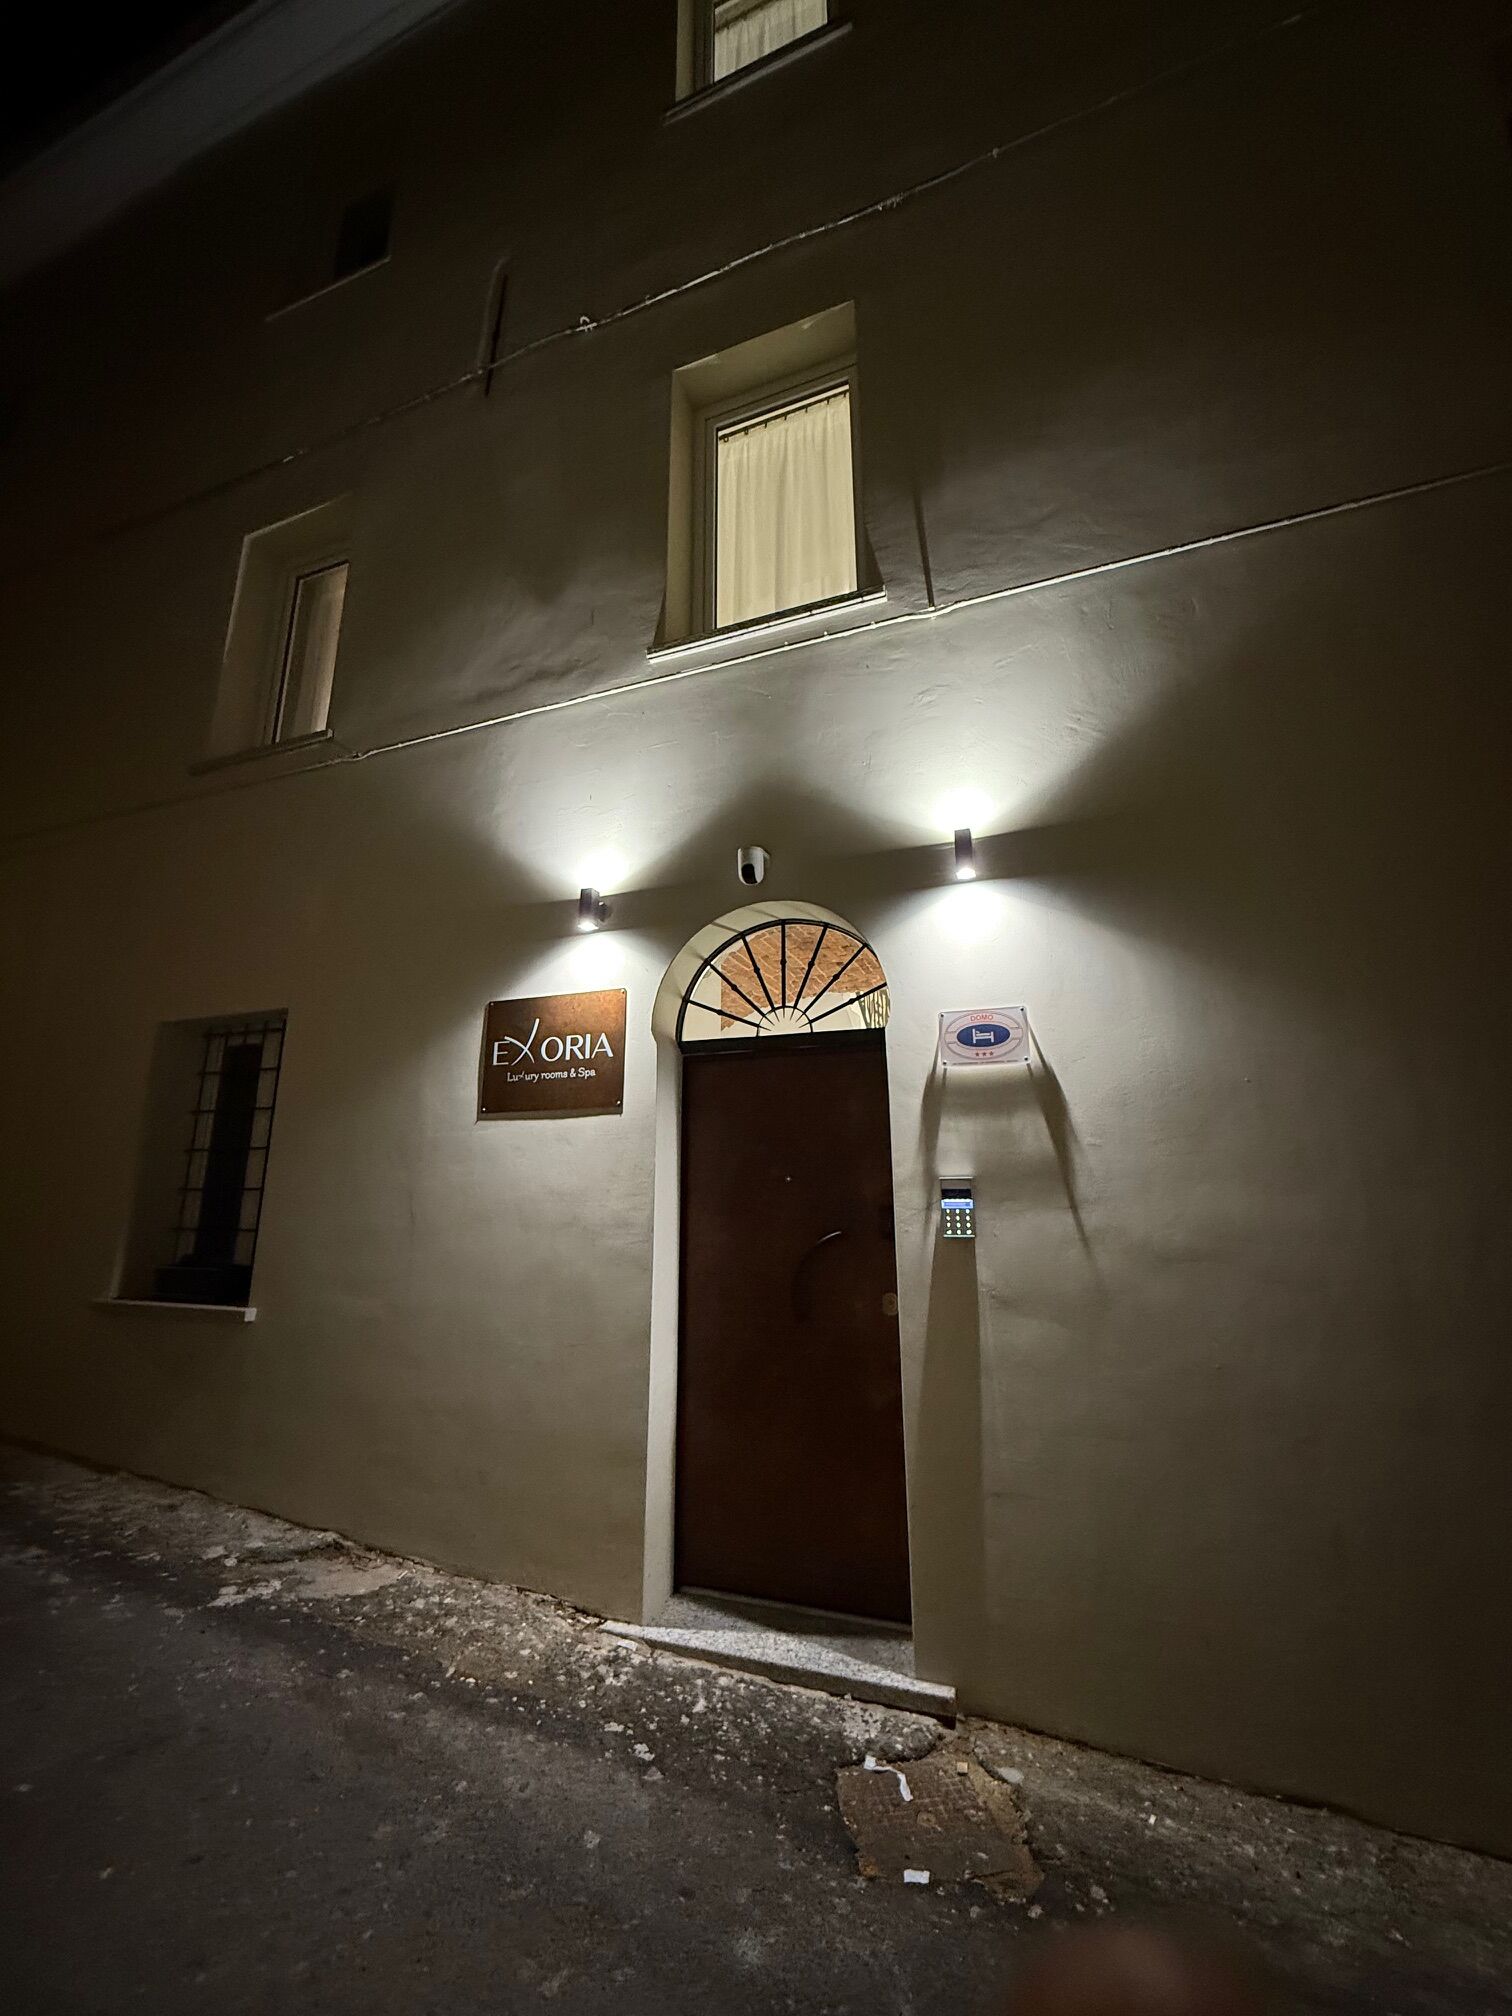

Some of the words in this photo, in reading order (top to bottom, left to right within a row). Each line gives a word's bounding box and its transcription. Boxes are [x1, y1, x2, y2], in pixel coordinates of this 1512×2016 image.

[970, 1014, 994, 1022] DOMO
[492, 1018, 614, 1066] EXORIA
[507, 1071, 539, 1083] Luxury
[541, 1070, 568, 1080] rooms
[569, 1068, 577, 1078] &
[578, 1067, 596, 1079] Spa
